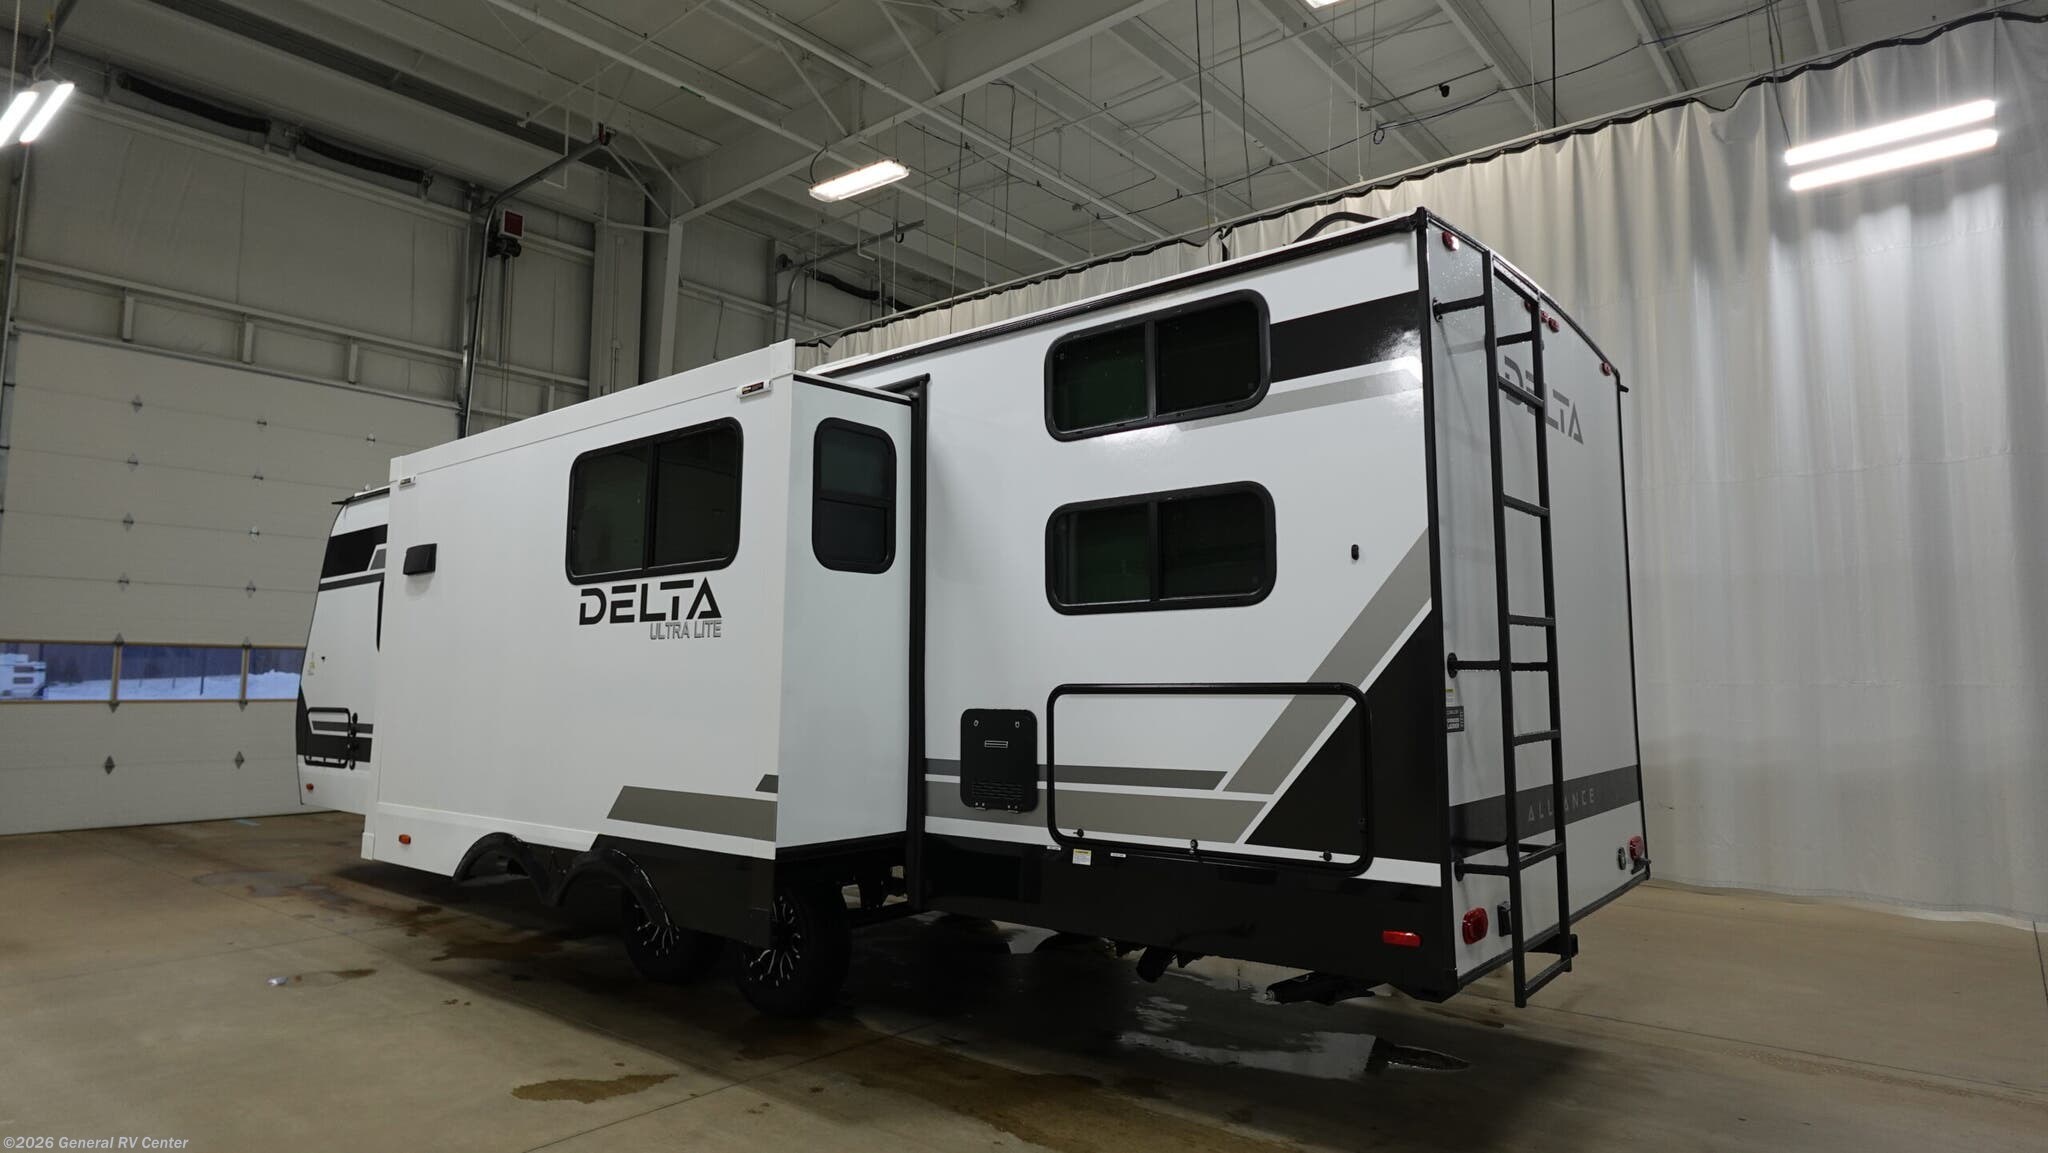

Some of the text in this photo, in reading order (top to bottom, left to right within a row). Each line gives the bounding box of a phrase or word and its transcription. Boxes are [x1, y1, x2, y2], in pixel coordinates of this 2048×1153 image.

[579, 576, 722, 626] DELTA
[650, 621, 722, 640] ULTRA LITE
[1528, 787, 1595, 822] ALLANCE
